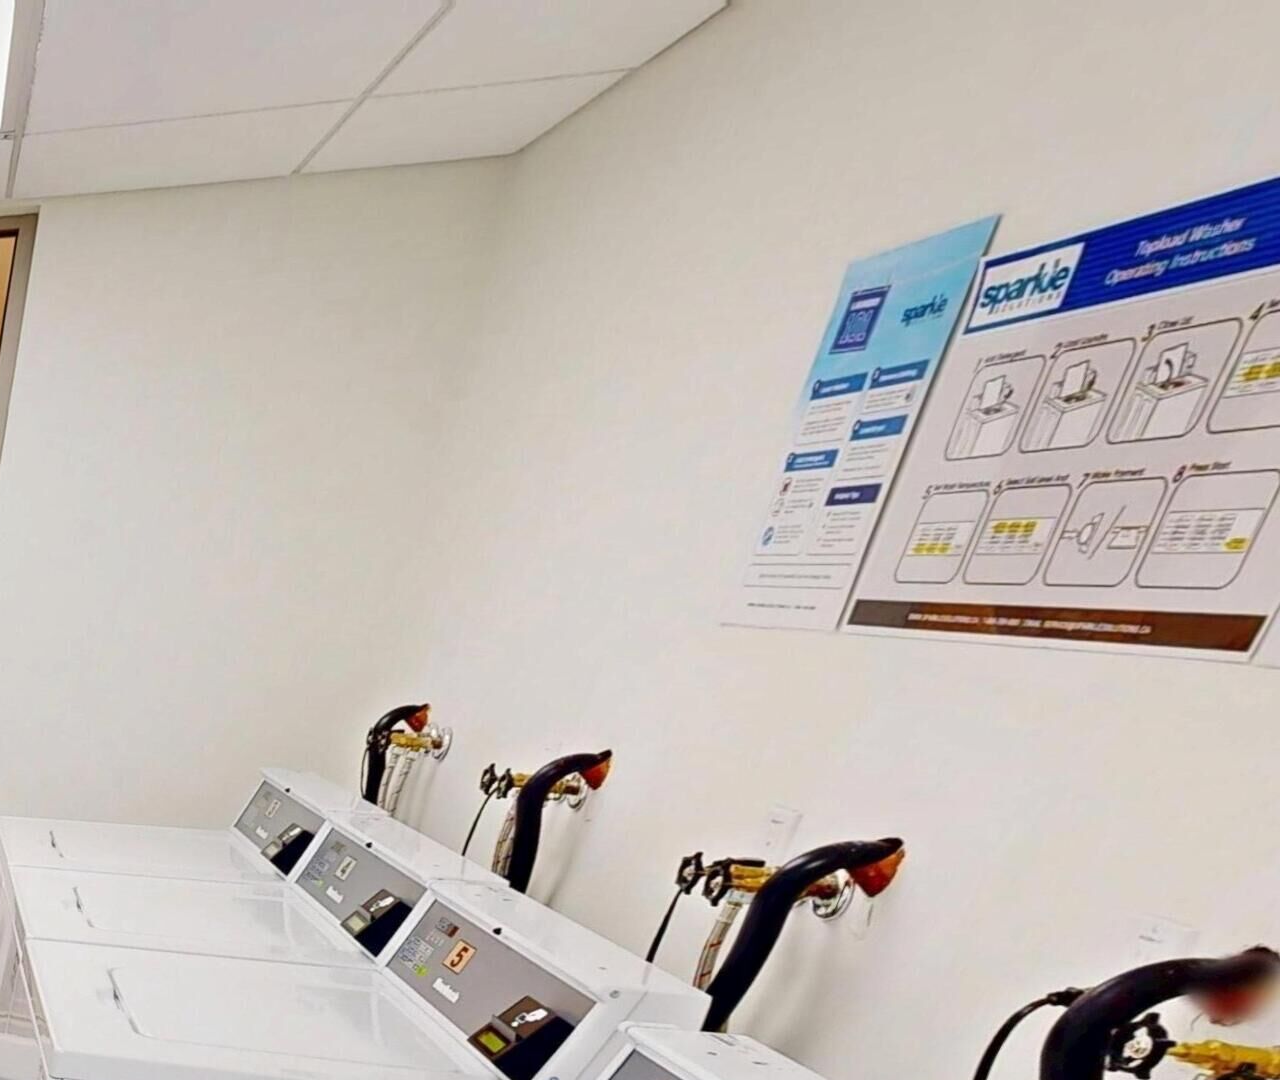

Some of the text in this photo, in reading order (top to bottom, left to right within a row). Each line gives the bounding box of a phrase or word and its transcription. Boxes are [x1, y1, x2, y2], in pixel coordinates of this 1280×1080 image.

[1135, 217, 1247, 257] Topload Washer
[1104, 238, 1257, 286] Operating Instructions
[979, 259, 1070, 315] sparkle
[1249, 302, 1266, 321] 4
[1142, 324, 1156, 342] 3
[1050, 342, 1063, 359] 2
[450, 946, 469, 967] 5
